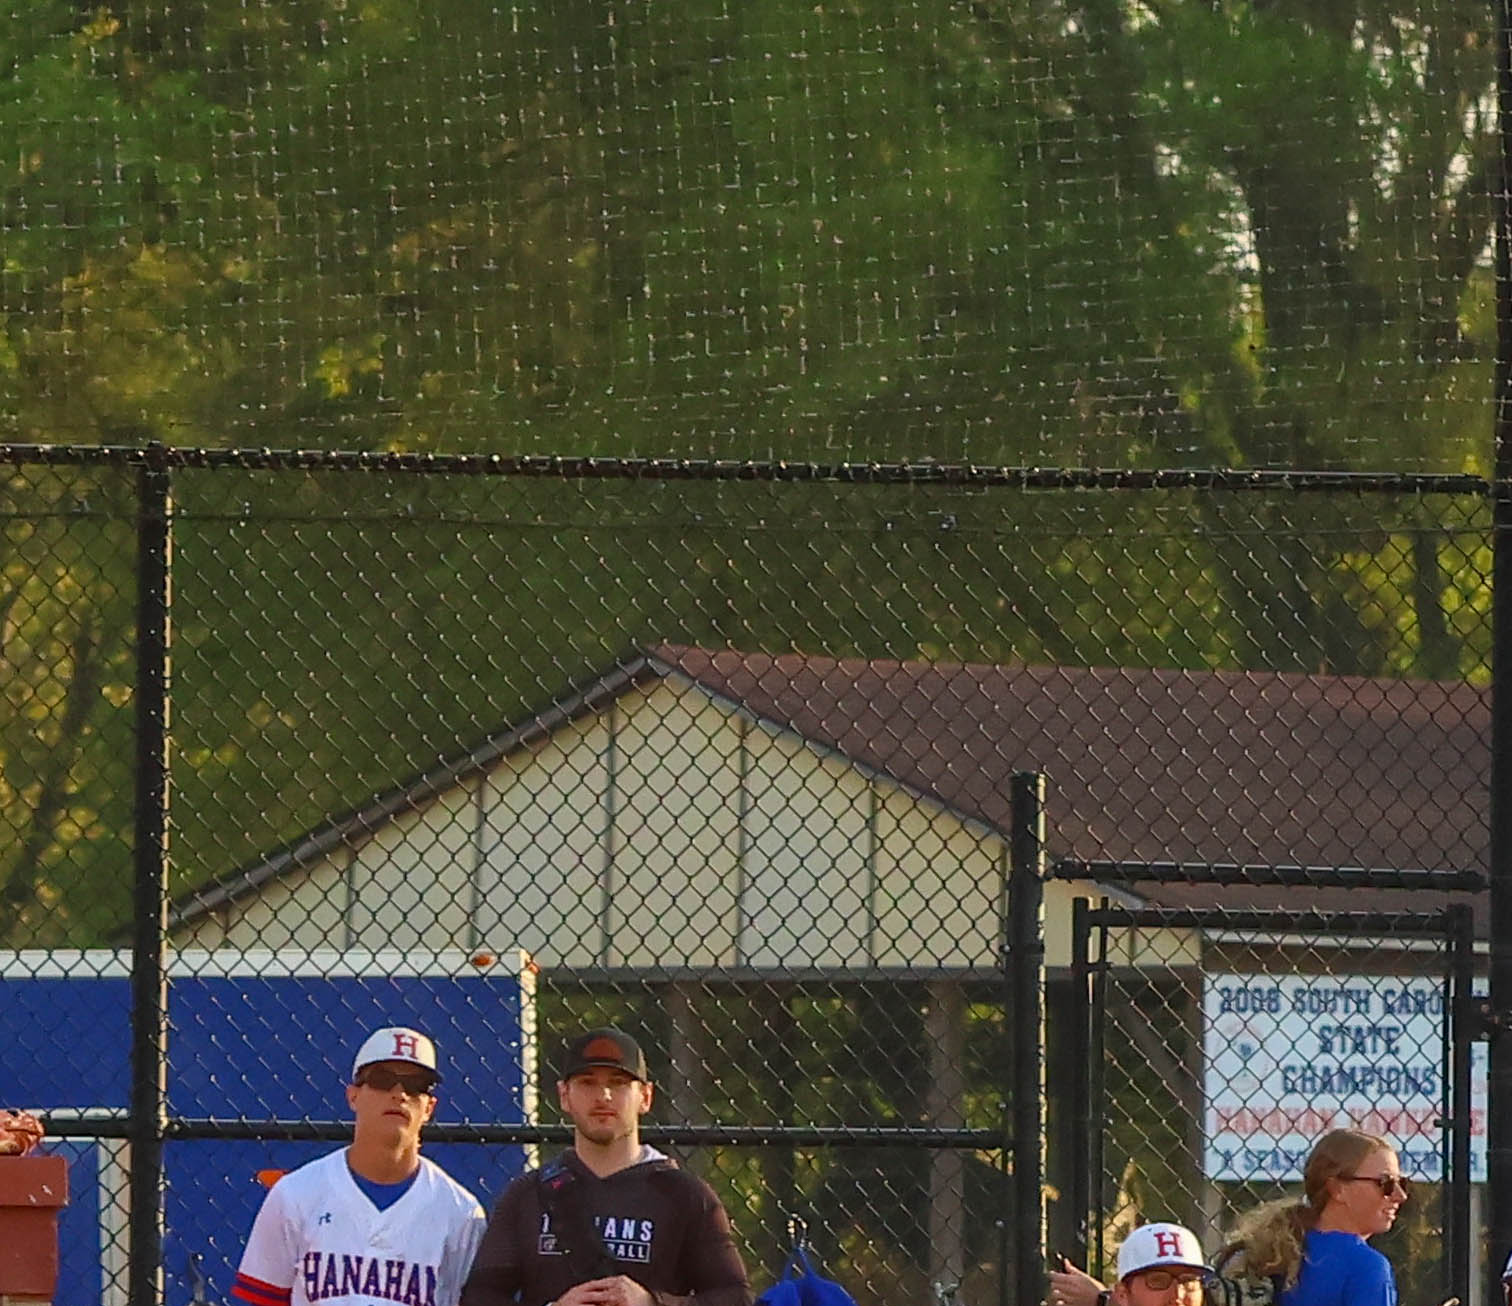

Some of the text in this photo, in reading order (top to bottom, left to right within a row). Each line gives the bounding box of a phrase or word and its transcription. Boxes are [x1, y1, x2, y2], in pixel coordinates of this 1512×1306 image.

[1219, 986, 1443, 1016] 2008 SOUTH CARO
[391, 1033, 420, 1060] H
[1319, 1025, 1400, 1055] STATE
[1282, 1065, 1436, 1097] CHAMPIONS
[1153, 1231, 1184, 1258] H
